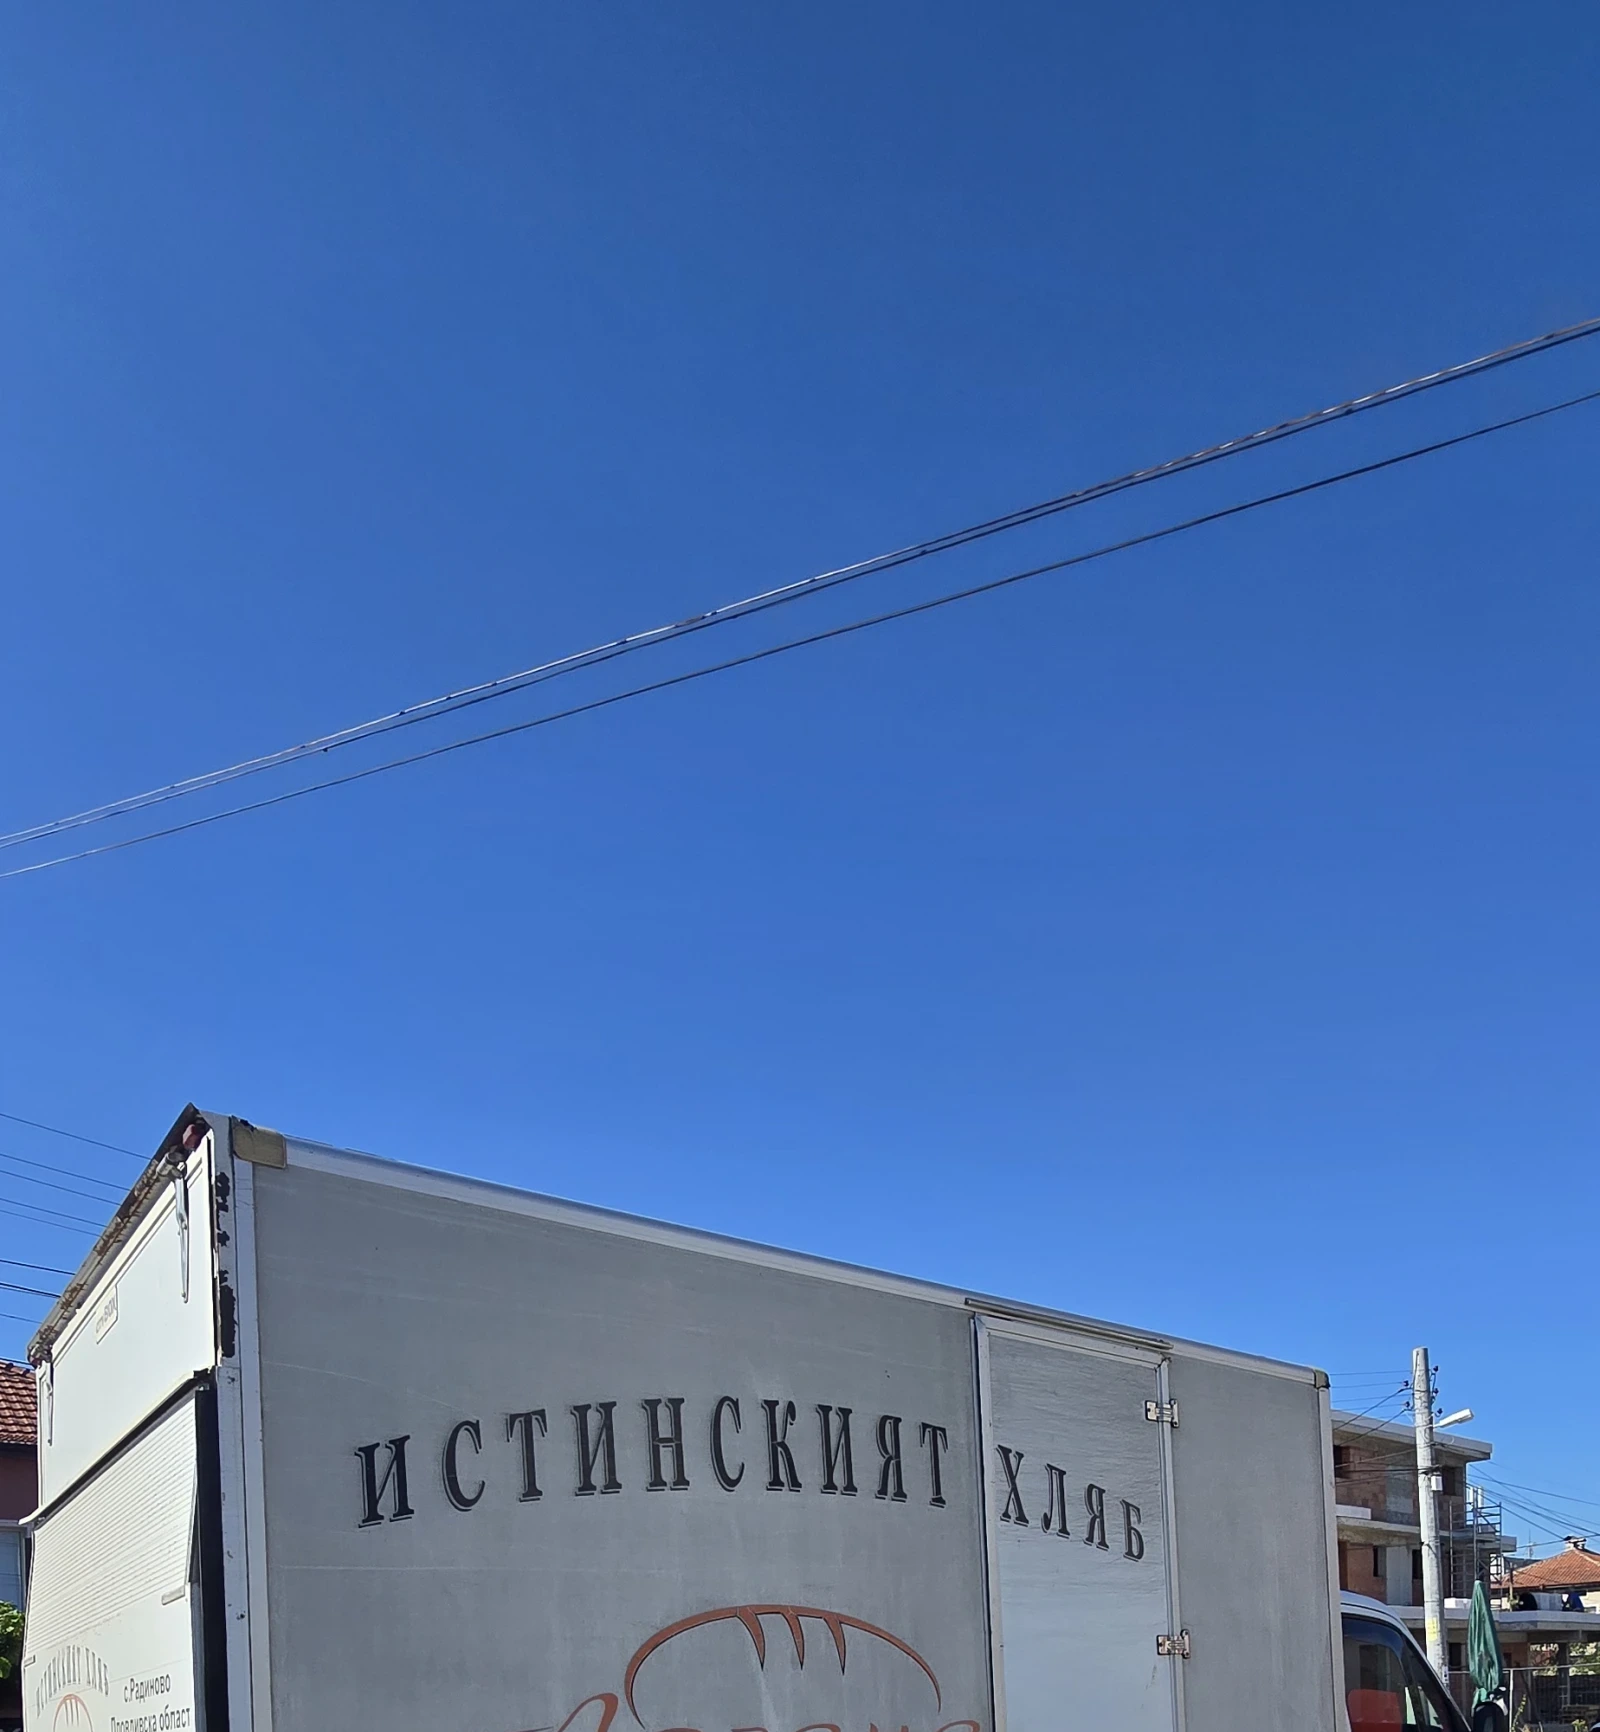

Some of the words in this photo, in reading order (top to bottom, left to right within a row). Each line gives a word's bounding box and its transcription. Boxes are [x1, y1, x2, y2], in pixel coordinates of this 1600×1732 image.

[354, 1395, 949, 1529] ИСТИНСКИЯТ
[995, 1444, 1145, 1563] ХЛЯБ
[160, 1704, 190, 1731] област
